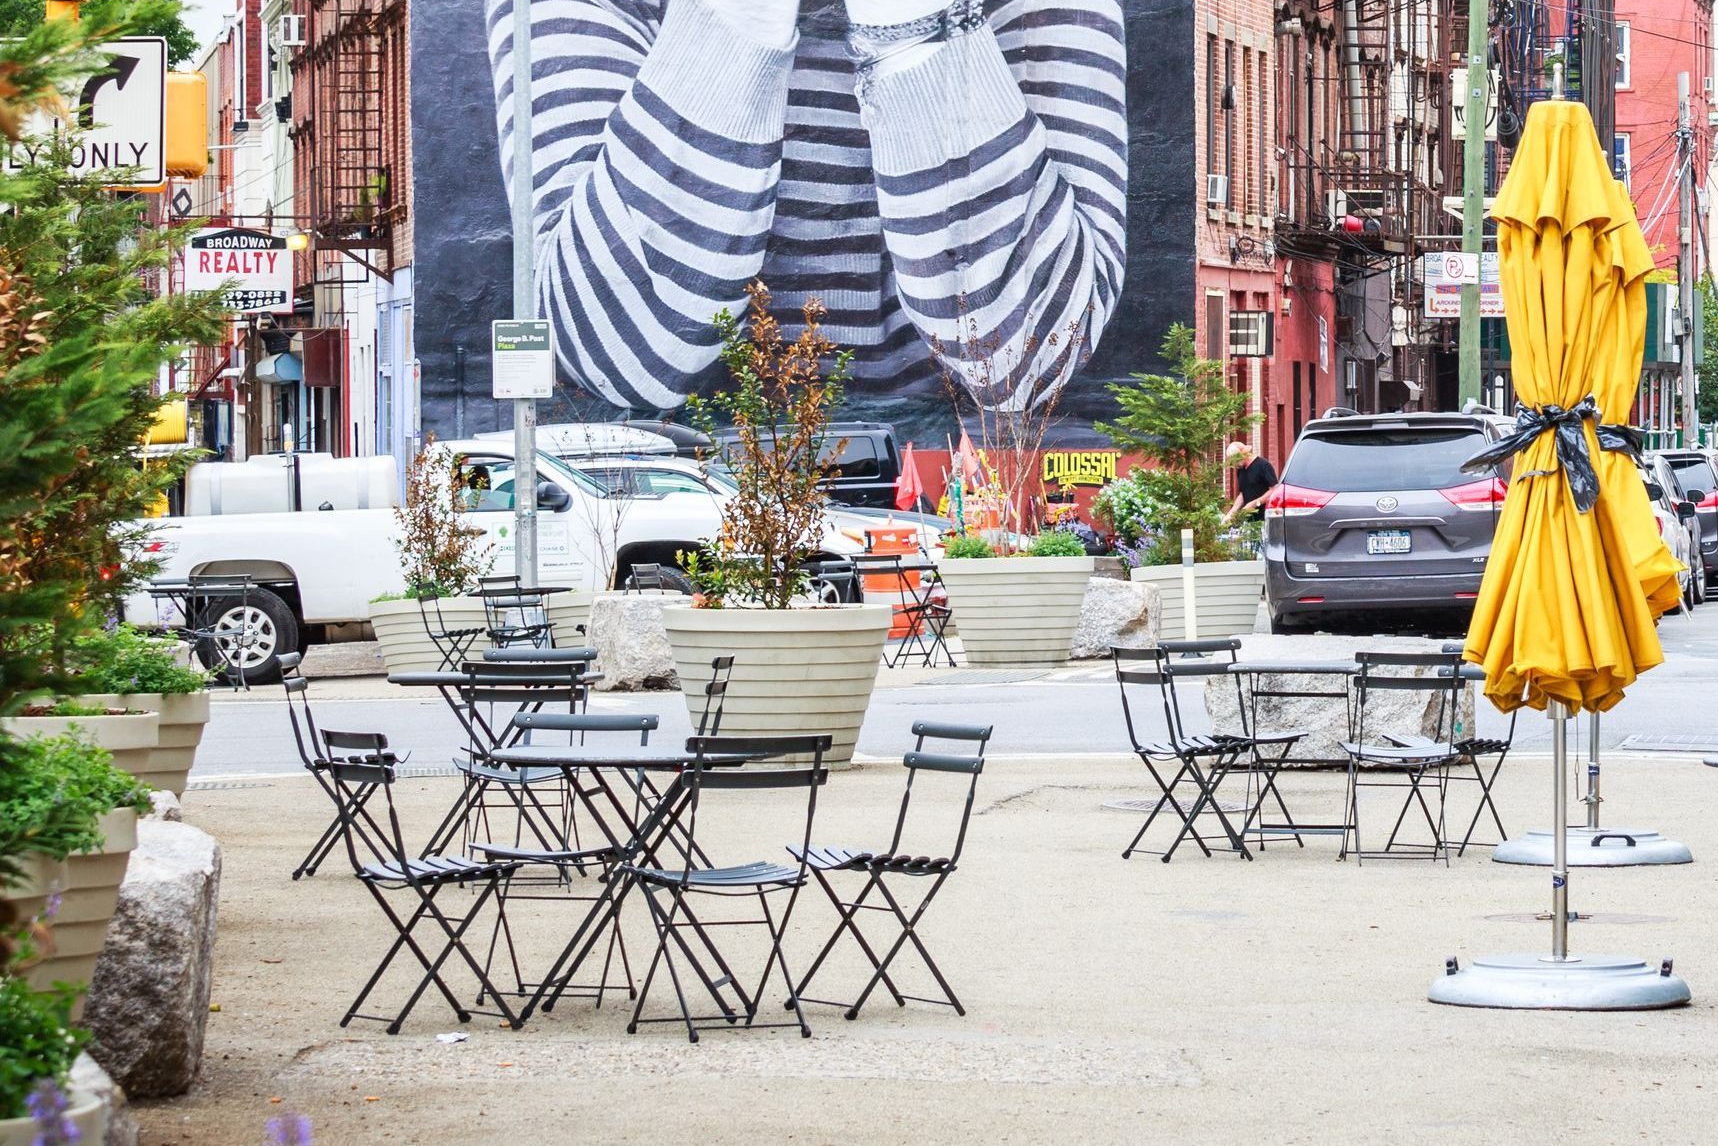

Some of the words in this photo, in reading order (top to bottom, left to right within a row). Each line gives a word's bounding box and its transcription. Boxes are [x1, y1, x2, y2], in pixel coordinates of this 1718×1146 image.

[9, 142, 43, 169] LY
[69, 142, 149, 169] ONLY
[206, 235, 273, 248] BROADWAY
[199, 251, 278, 274] REALTY
[497, 335, 522, 343] George
[1043, 452, 1118, 481] COLOSSAL
